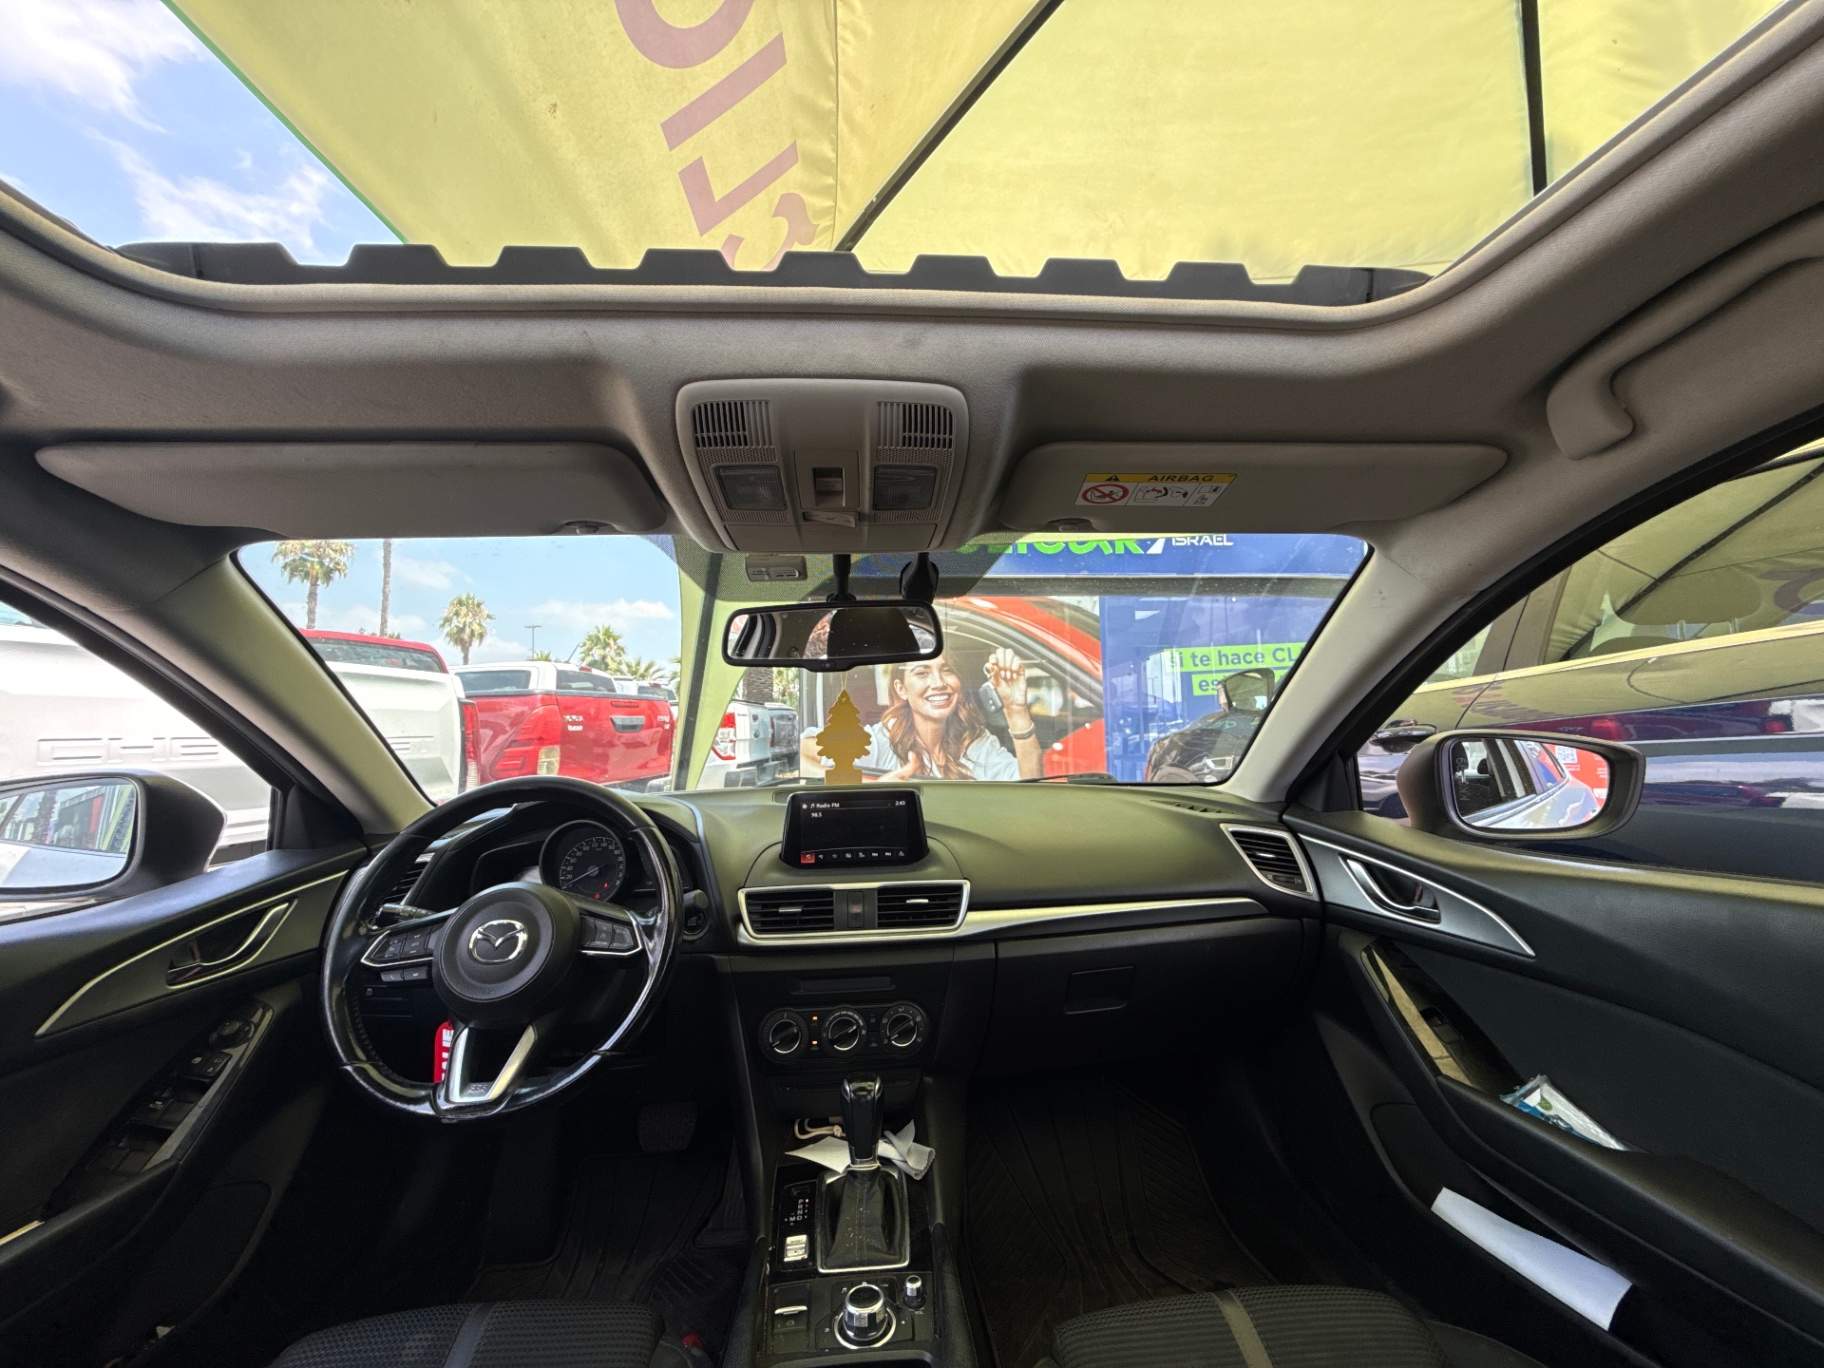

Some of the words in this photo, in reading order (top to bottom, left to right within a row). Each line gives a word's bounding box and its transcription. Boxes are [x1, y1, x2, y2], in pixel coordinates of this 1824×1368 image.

[1148, 474, 1214, 482] AIRBAG
[1171, 533, 1234, 547] ISRAEL
[1190, 651, 1211, 668] te
[1217, 649, 1265, 667] hace
